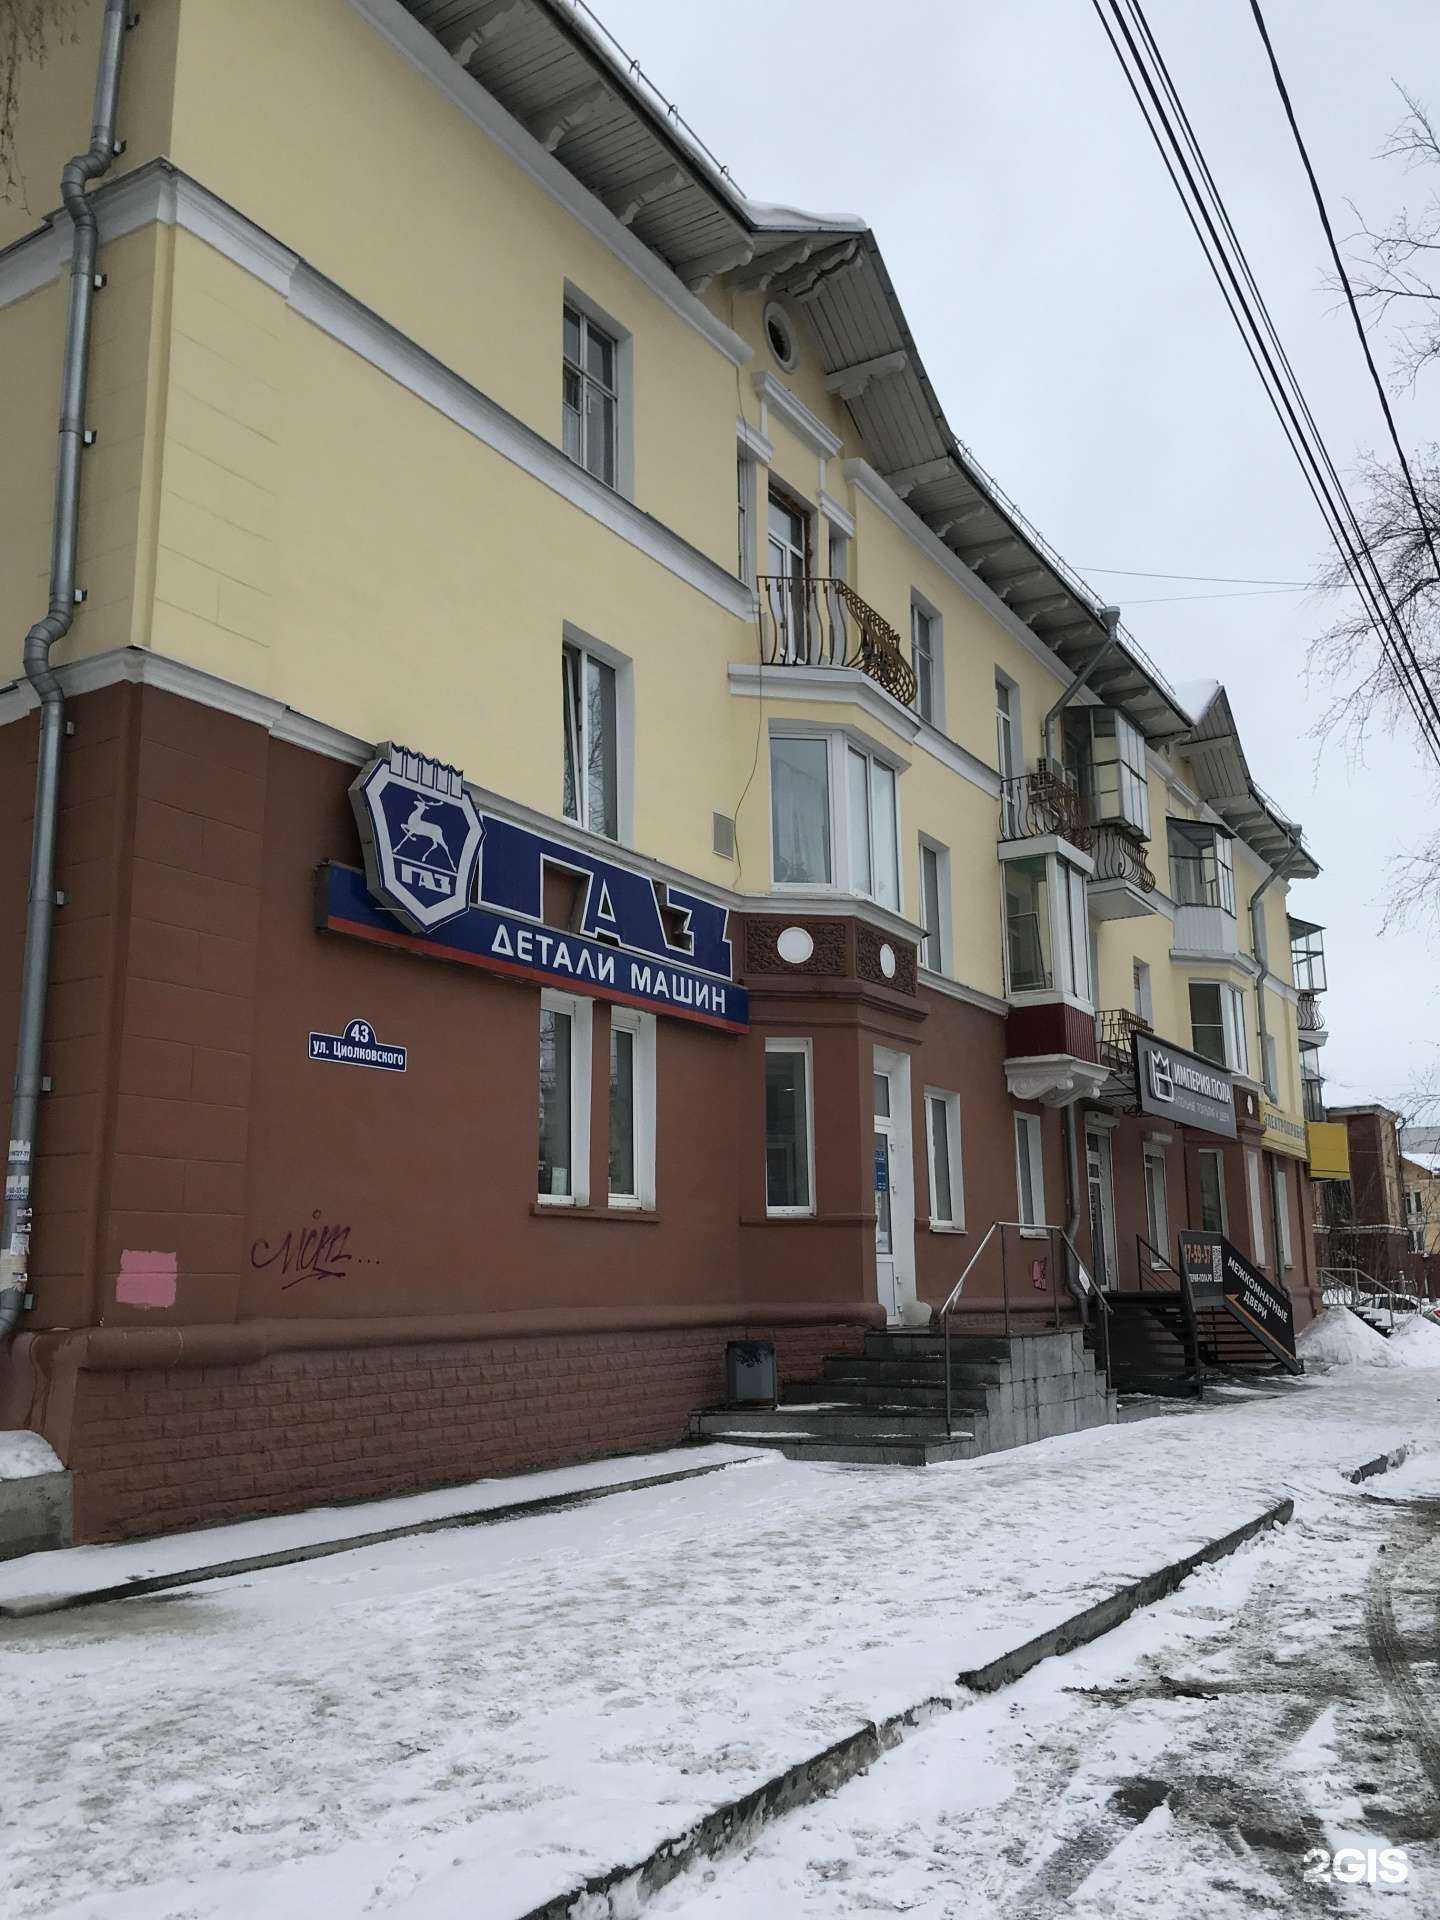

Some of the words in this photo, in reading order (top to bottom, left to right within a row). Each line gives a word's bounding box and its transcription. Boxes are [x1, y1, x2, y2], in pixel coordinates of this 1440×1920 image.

[401, 863, 451, 895] ГАЗ
[477, 812, 734, 981] ГАЗ
[491, 924, 615, 984] ДЕТАЛИ
[630, 962, 726, 1014] МАШИН
[351, 1023, 369, 1043] 43
[312, 1040, 329, 1055] ул.
[333, 1041, 404, 1065] Циолковского
[1173, 1063, 1210, 1097] ИМПЕРИЯ
[1211, 1078, 1233, 1104] ПОЛА
[1227, 1256, 1289, 1323] МЕЖКОМНАТНЫЕ
[1243, 1290, 1268, 1320] ДВЕРИ
